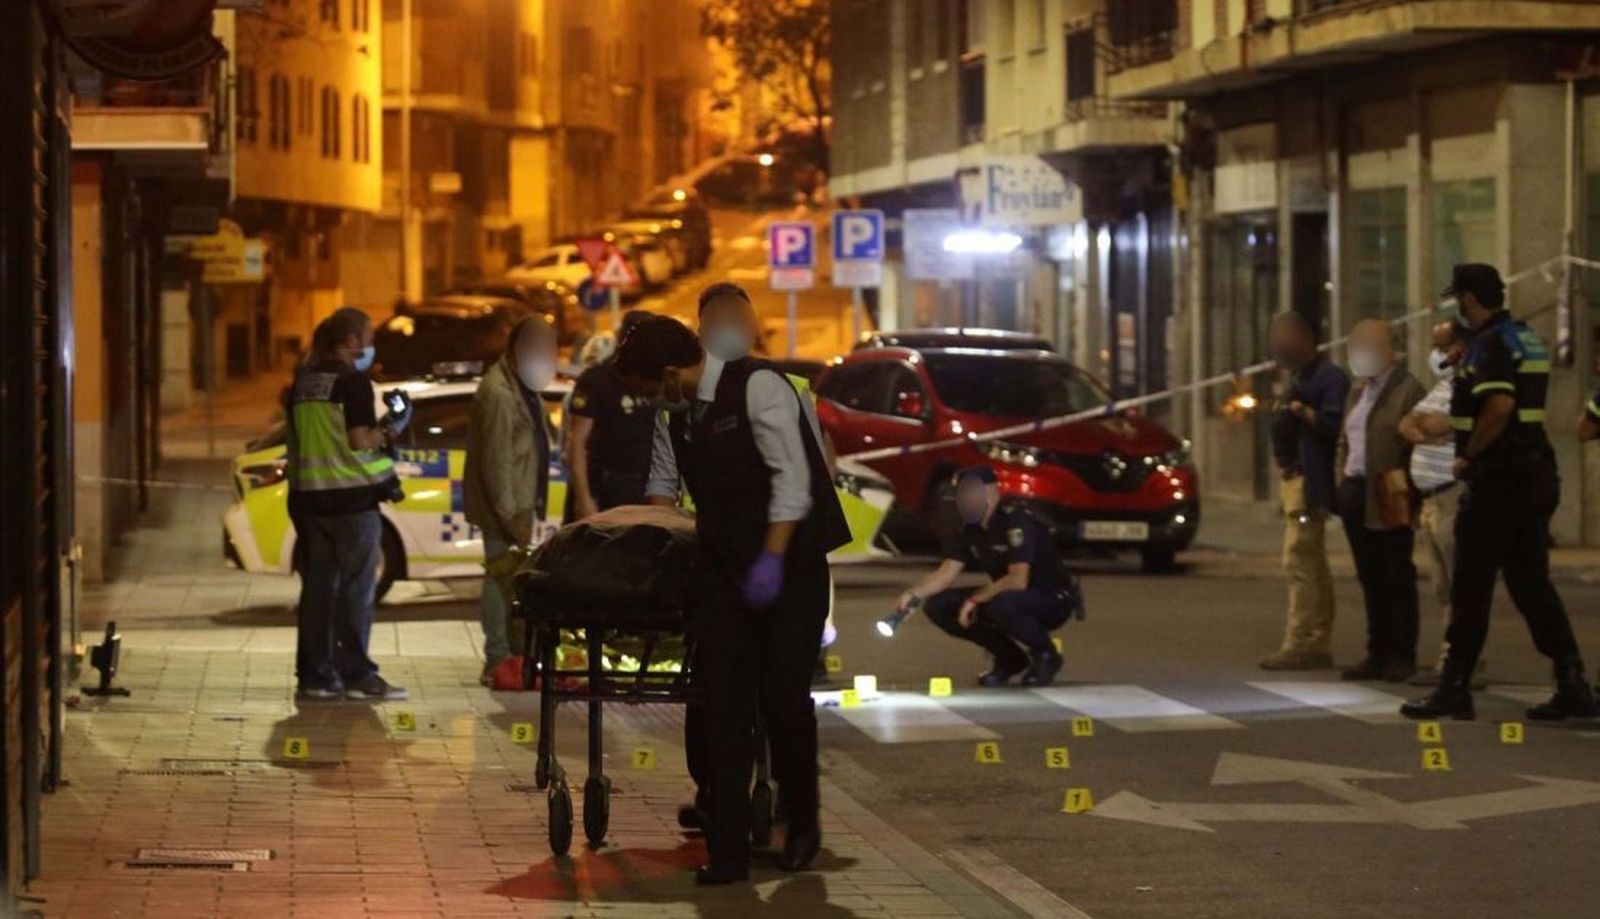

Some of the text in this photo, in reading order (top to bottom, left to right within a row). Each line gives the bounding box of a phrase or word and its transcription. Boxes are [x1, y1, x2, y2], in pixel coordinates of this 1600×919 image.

[842, 217, 874, 255] P
[777, 227, 806, 262] P
[1077, 720, 1089, 731] 11
[1425, 726, 1435, 738] 4
[1507, 726, 1517, 738] 3
[516, 727, 526, 740] 9
[290, 741, 301, 755] 8
[984, 746, 994, 759] 6
[638, 751, 649, 765] 7
[1053, 752, 1063, 764] 5
[1431, 752, 1441, 765] 2
[1073, 793, 1081, 805] 1
